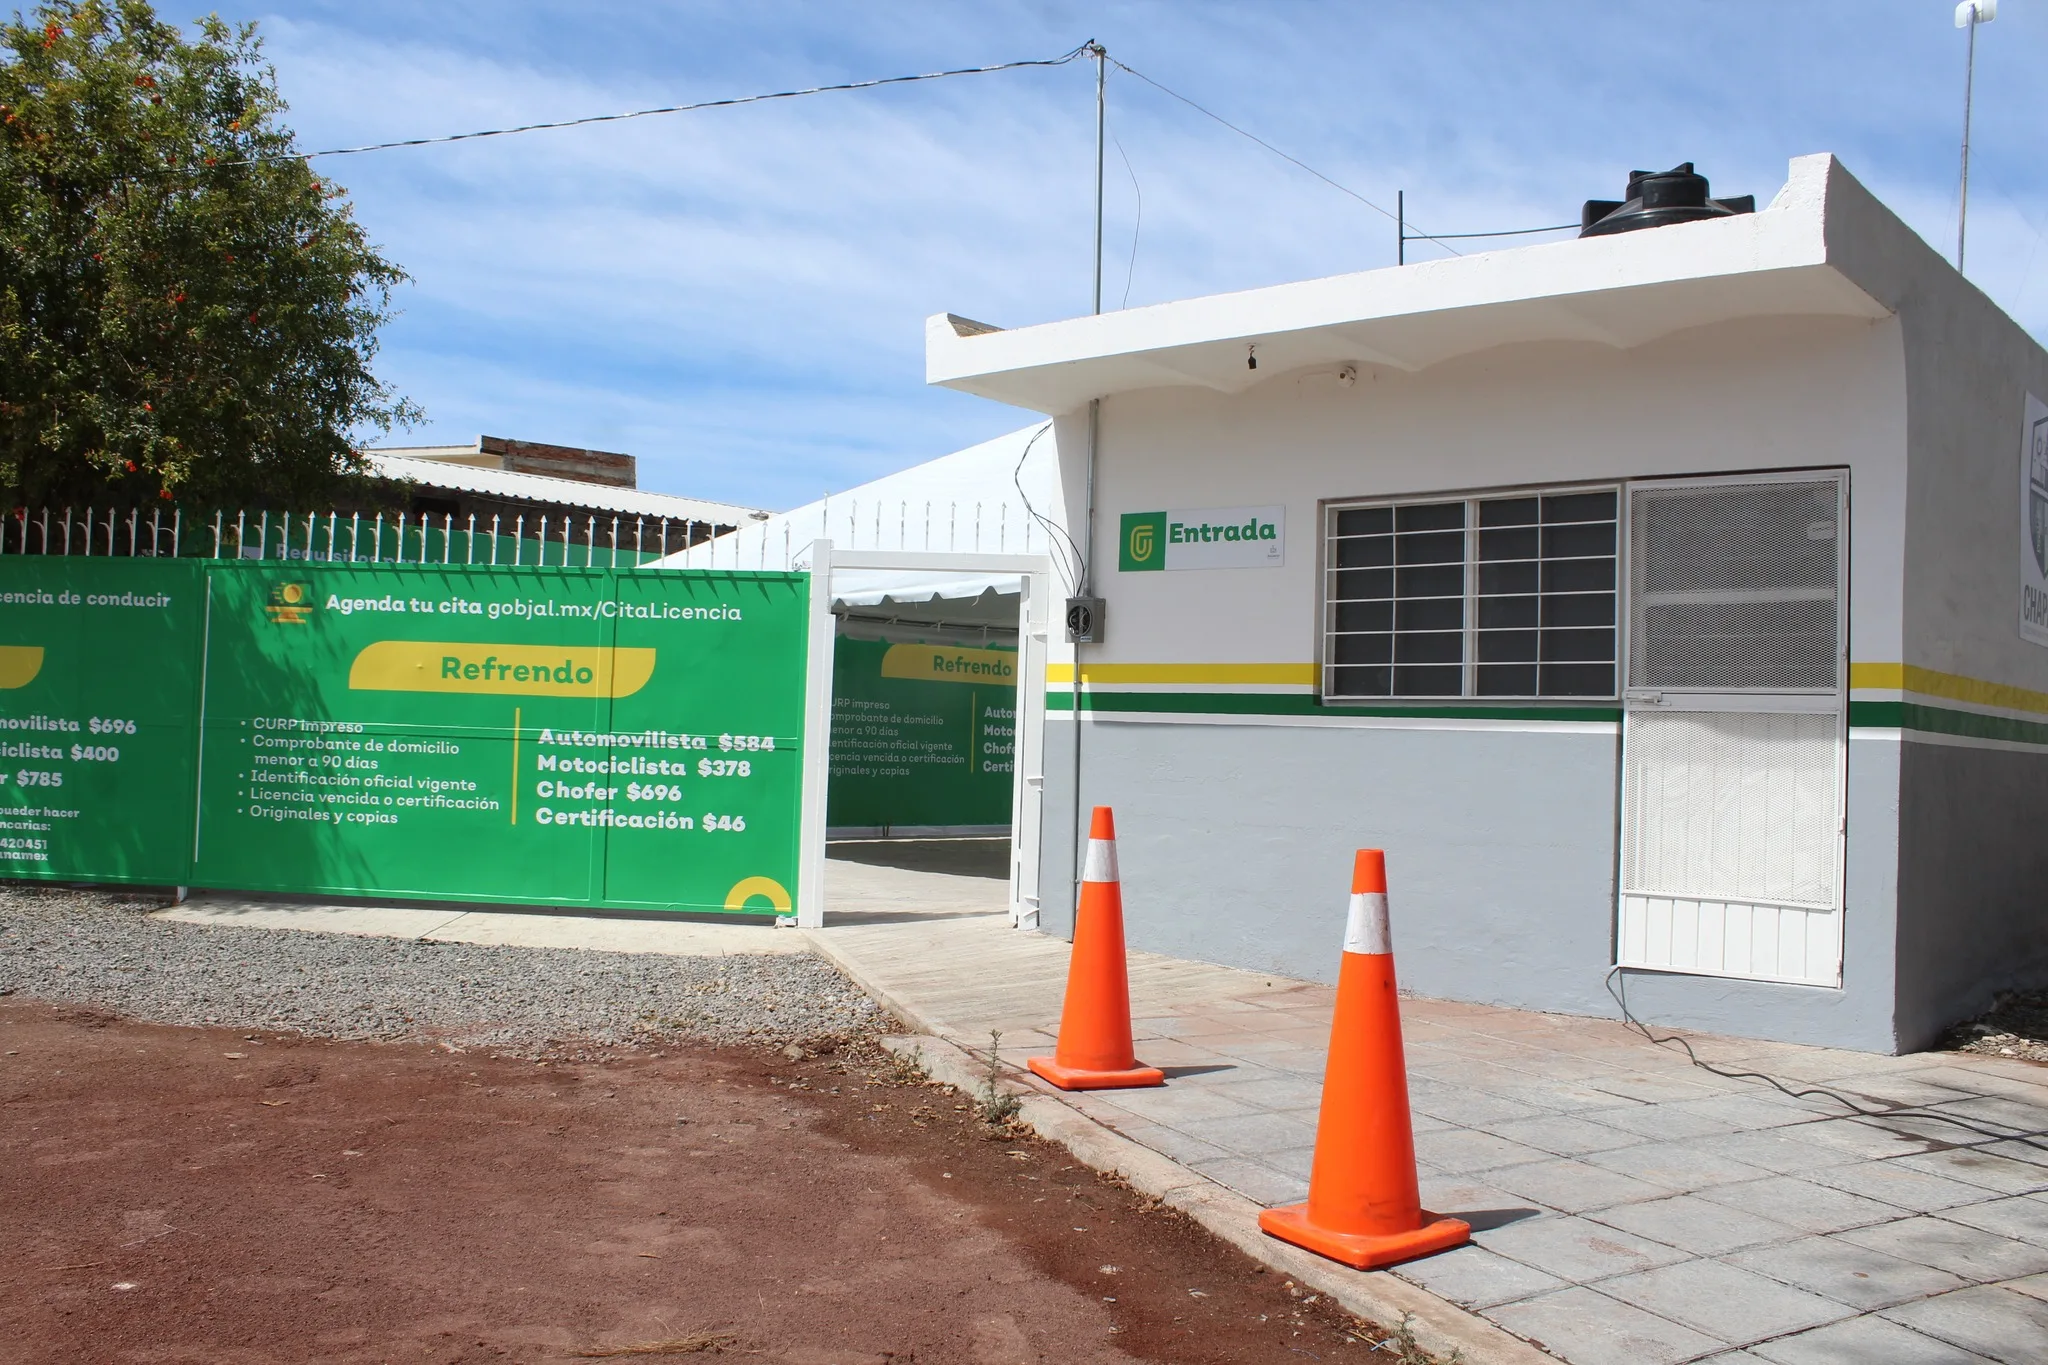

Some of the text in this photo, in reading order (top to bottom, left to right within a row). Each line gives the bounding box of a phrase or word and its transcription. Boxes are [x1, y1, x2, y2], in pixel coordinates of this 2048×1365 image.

[1169, 518, 1276, 544] Entrada
[58, 590, 81, 605] de
[86, 591, 171, 608] conducir
[325, 594, 742, 621] Agenda tu cita gobjal.mx/CitaLicencia
[441, 656, 594, 685] Refrendo
[933, 655, 1012, 676] Refrendo
[852, 699, 890, 711] impreso
[89, 716, 137, 735] $696
[253, 717, 363, 735] CURP impreso
[890, 714, 902, 723] de
[903, 714, 944, 726] domicilio
[538, 728, 775, 752] Automovilista $584
[830, 727, 854, 735] enor
[856, 727, 863, 735] a
[864, 726, 877, 736] 90
[0, 741, 119, 762] iclista $400
[253, 734, 460, 755] Comprobante de domicilio
[829, 738, 953, 753] entificación oficial vigente
[254, 755, 379, 769] menor a 90 días
[537, 754, 751, 778] Motociclista $378
[863, 753, 900, 762] vencida
[908, 753, 965, 764] certificación
[16, 768, 63, 787] $785
[250, 769, 477, 793] Identificación oficial vigente
[872, 768, 878, 778] y
[880, 766, 910, 778] copias
[250, 787, 500, 810] Licencia vencida o certificación
[536, 780, 682, 802] Chofer $696
[44, 806, 80, 818] hacer
[250, 805, 398, 826] Originales y copias
[535, 807, 746, 833] Certificación $46
[0, 837, 47, 850] 420451
